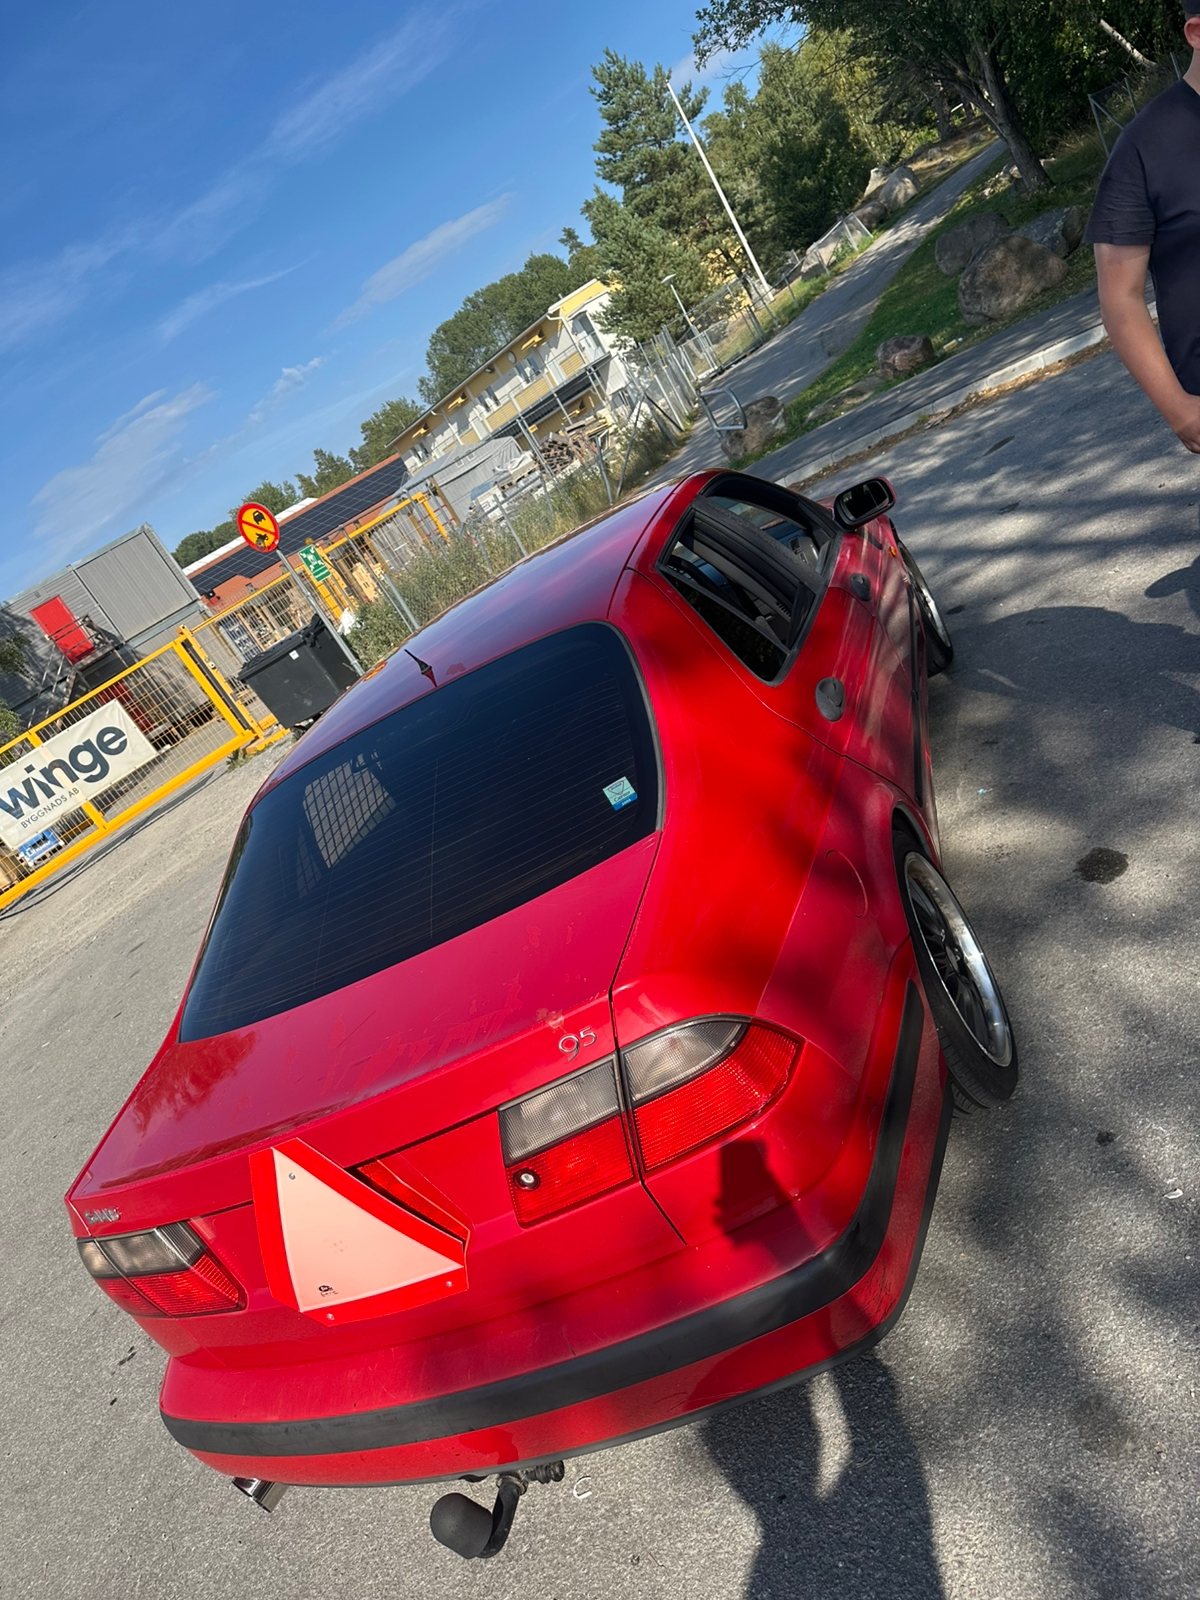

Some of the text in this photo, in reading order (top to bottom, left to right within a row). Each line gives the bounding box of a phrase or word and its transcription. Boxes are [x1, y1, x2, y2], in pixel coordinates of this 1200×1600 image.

[0, 726, 128, 820] winge
[20, 787, 80, 829] BYGGNADS AB
[558, 1027, 597, 1062] 95
